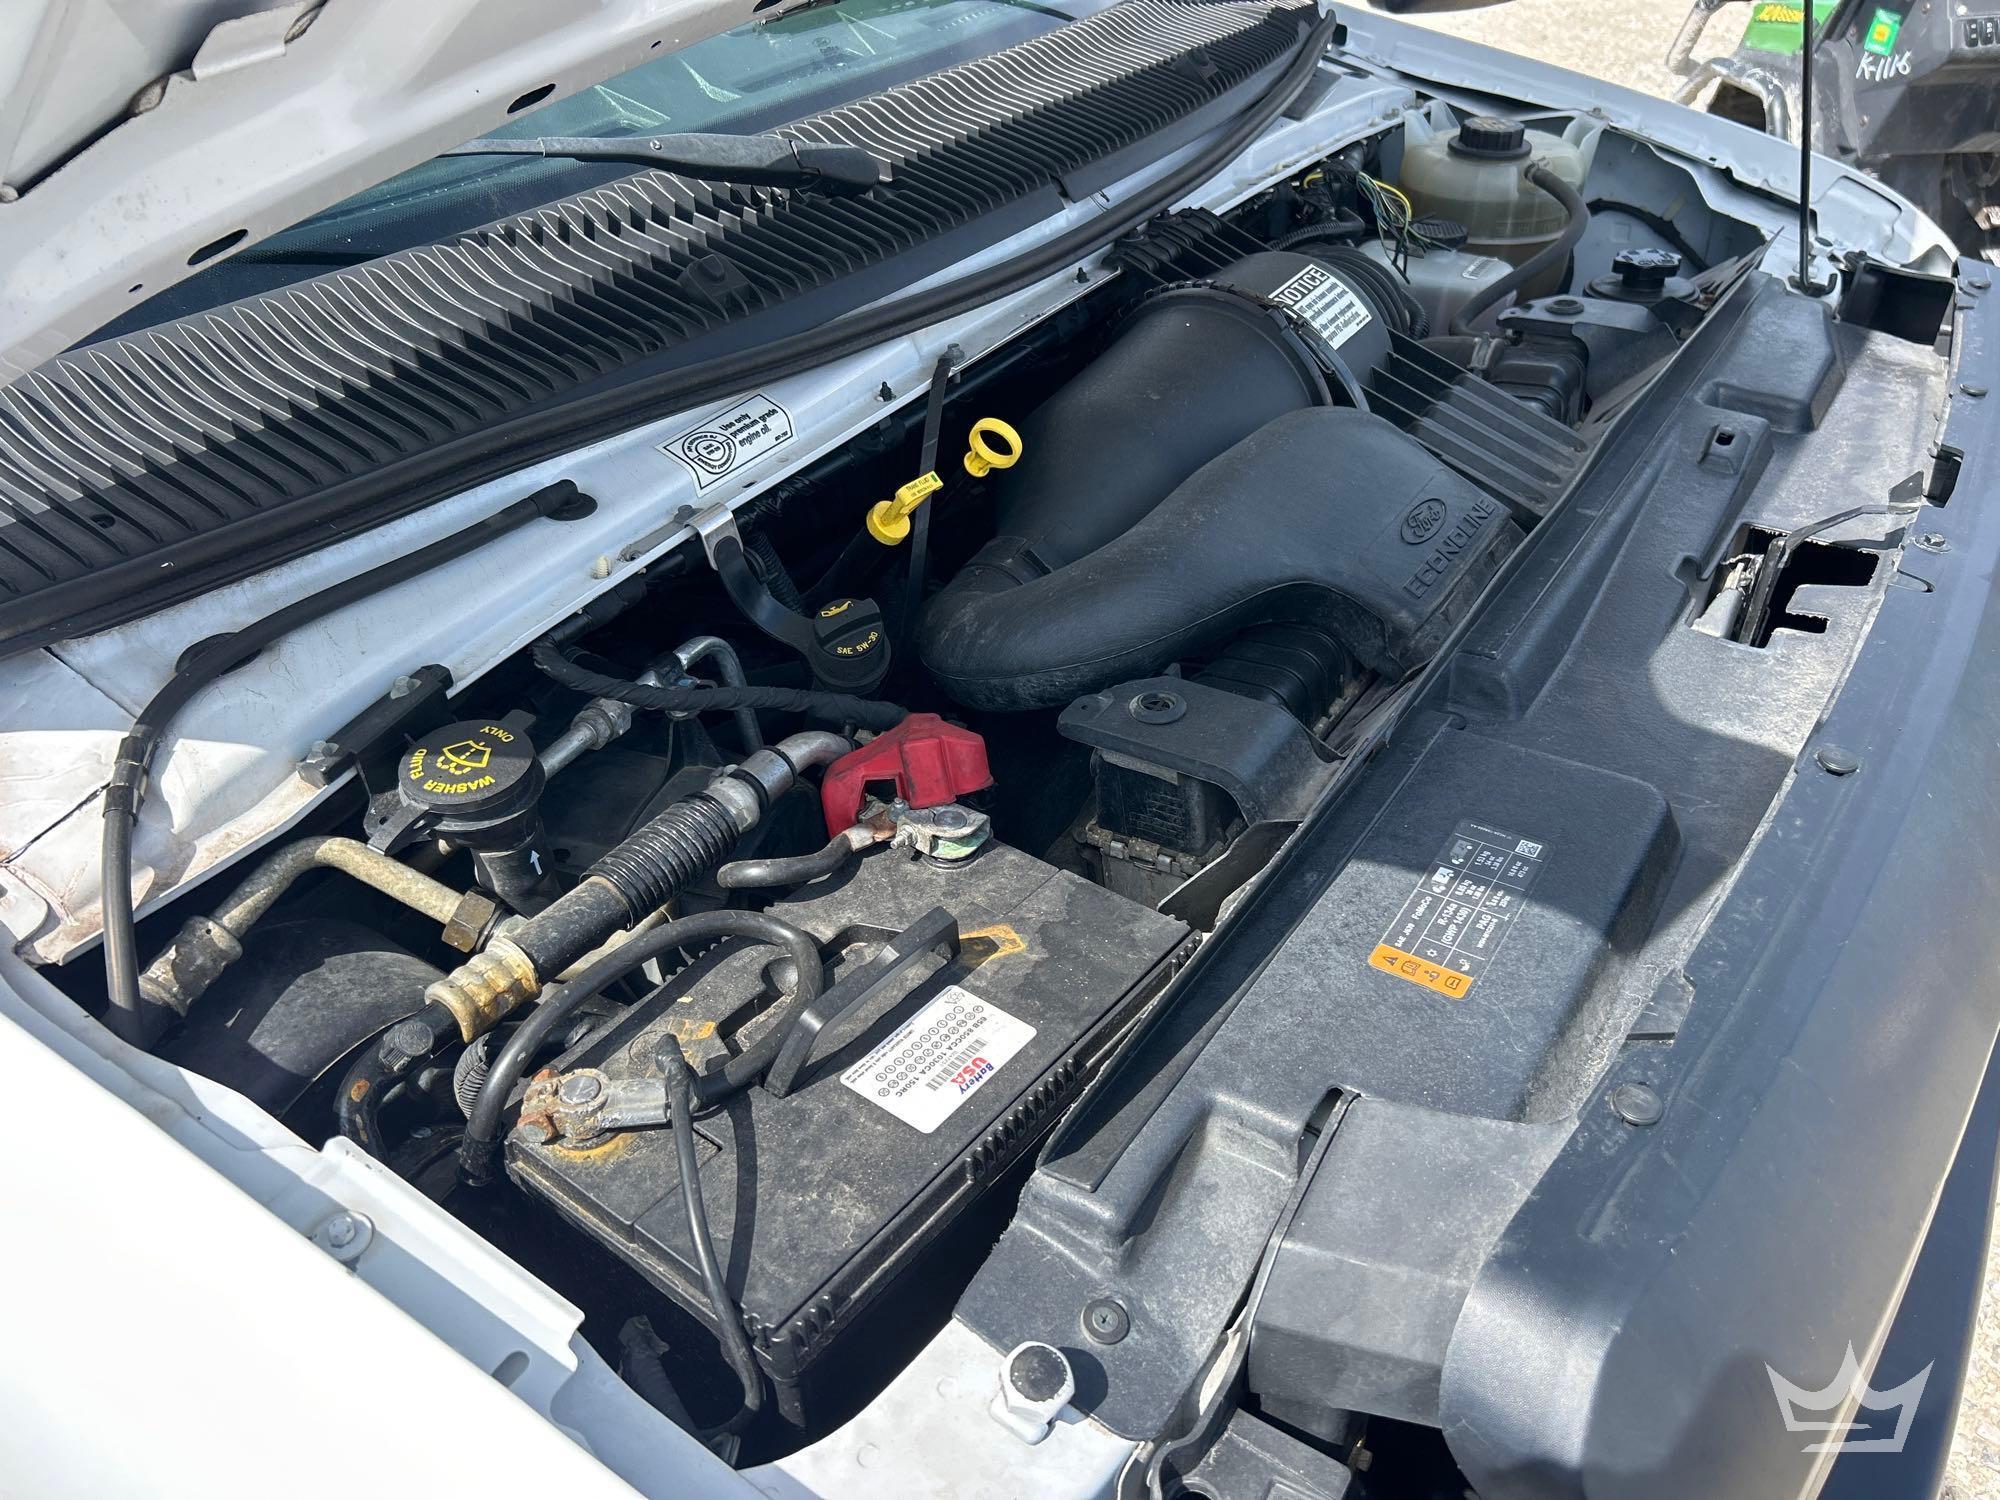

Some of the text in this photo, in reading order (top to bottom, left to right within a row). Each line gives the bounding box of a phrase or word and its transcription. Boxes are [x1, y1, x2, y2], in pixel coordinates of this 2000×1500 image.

[1273, 267, 1328, 306] NOTICE
[719, 413, 751, 431] Use only
[730, 419, 760, 439] premium
[758, 408, 779, 422] grade
[739, 430, 762, 447] engine
[1405, 502, 1443, 541] Ford
[1403, 499, 1497, 599] ECONOLINE
[836, 631, 879, 655] SAE 5W-30
[409, 725, 515, 794] WASHER FLUID ONLY
[1479, 849, 1491, 857] kg
[1460, 878, 1473, 886] kg
[1394, 935, 1407, 948] SAE
[1411, 895, 1433, 920] FoMoCo
[1437, 903, 1458, 926] R-134a
[1440, 907, 1472, 945] (GWP 1430)
[1475, 914, 1492, 930] PAG
[972, 1016, 988, 1029] 65B
[946, 1027, 975, 1050] 850CCA
[919, 1051, 947, 1075] 1030CA
[951, 1056, 988, 1085] USA
[895, 1076, 920, 1098] 150RC
[959, 1062, 995, 1095] Battery
